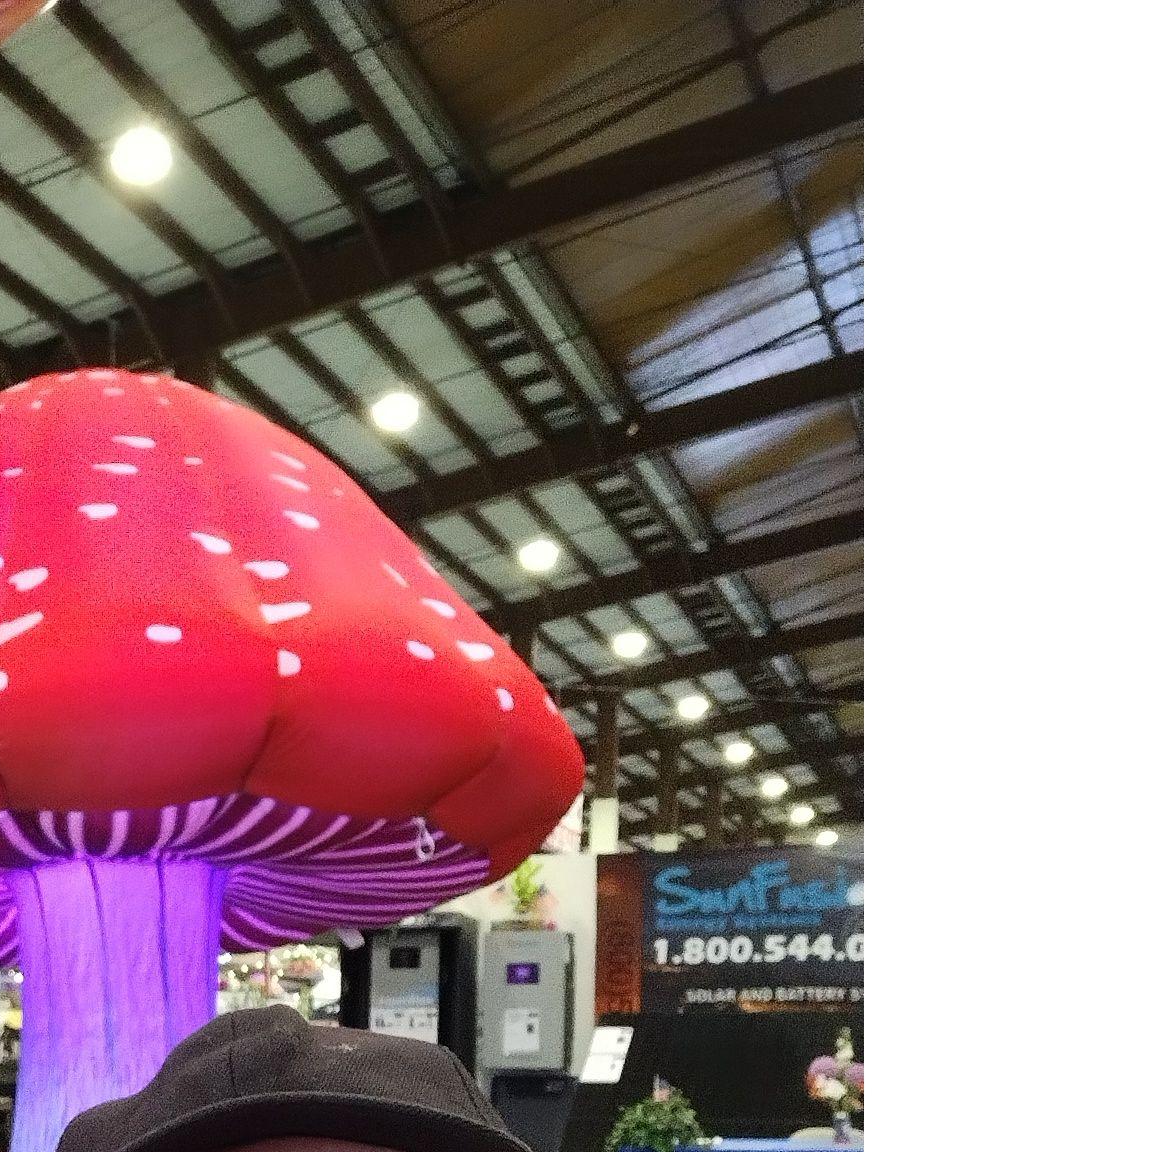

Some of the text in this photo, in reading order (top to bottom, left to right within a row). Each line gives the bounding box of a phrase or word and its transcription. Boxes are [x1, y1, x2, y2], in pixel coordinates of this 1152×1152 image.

[686, 989, 736, 1004] SOLAR
[739, 986, 774, 1002] AND
[775, 985, 847, 1002] BATTERY
